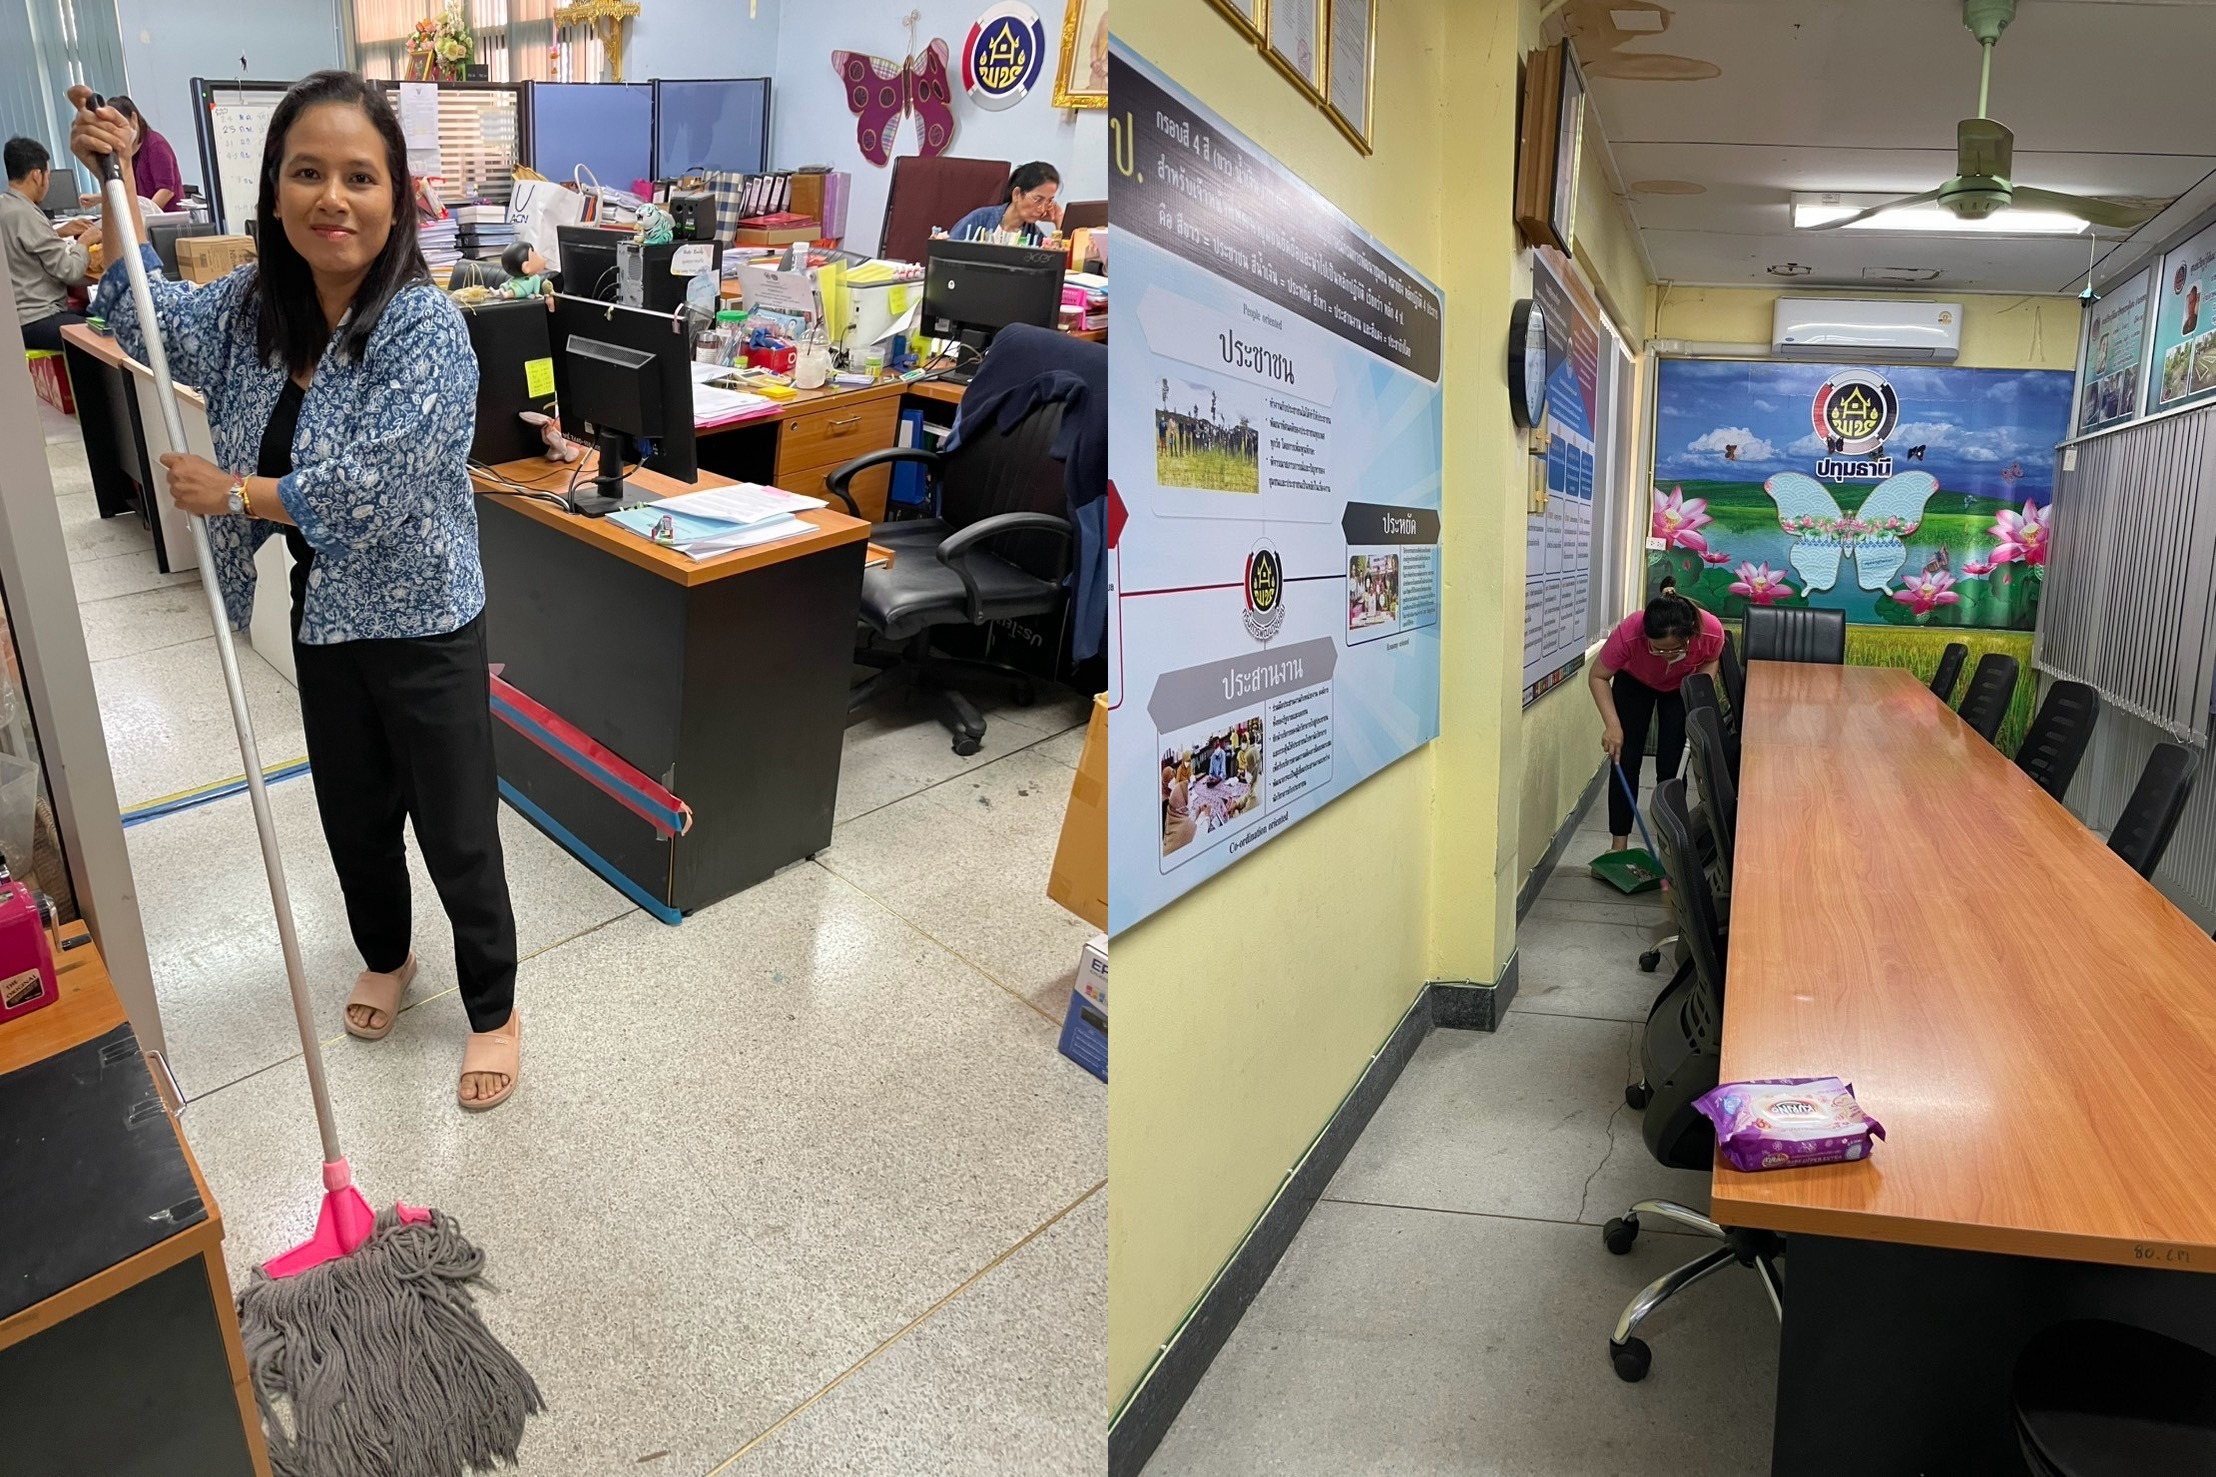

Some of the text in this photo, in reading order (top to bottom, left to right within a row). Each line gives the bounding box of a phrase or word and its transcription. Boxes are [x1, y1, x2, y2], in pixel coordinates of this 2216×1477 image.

[1110, 112, 1144, 183] ป.
[1156, 111, 1189, 148] กรอบสี
[1193, 134, 1200, 155] 4
[1203, 136, 1209, 161] สี
[1159, 202, 1172, 230] คือ
[1177, 212, 1199, 244] สีขาว
[1213, 236, 1248, 270] ประชาชน
[1251, 250, 1278, 286] สีน้ำเงิน
[1243, 303, 1283, 330] People oriented
[1219, 329, 1295, 385] ประชาชน
[1816, 457, 1893, 483] ปทุมธานี
[1382, 512, 1417, 535] ประหยัด
[1222, 658, 1304, 700] ประสานงาน
[1268, 810, 1289, 831] oriented
[6, 979, 18, 990] THE
[6, 974, 37, 999] ORIGINAL
